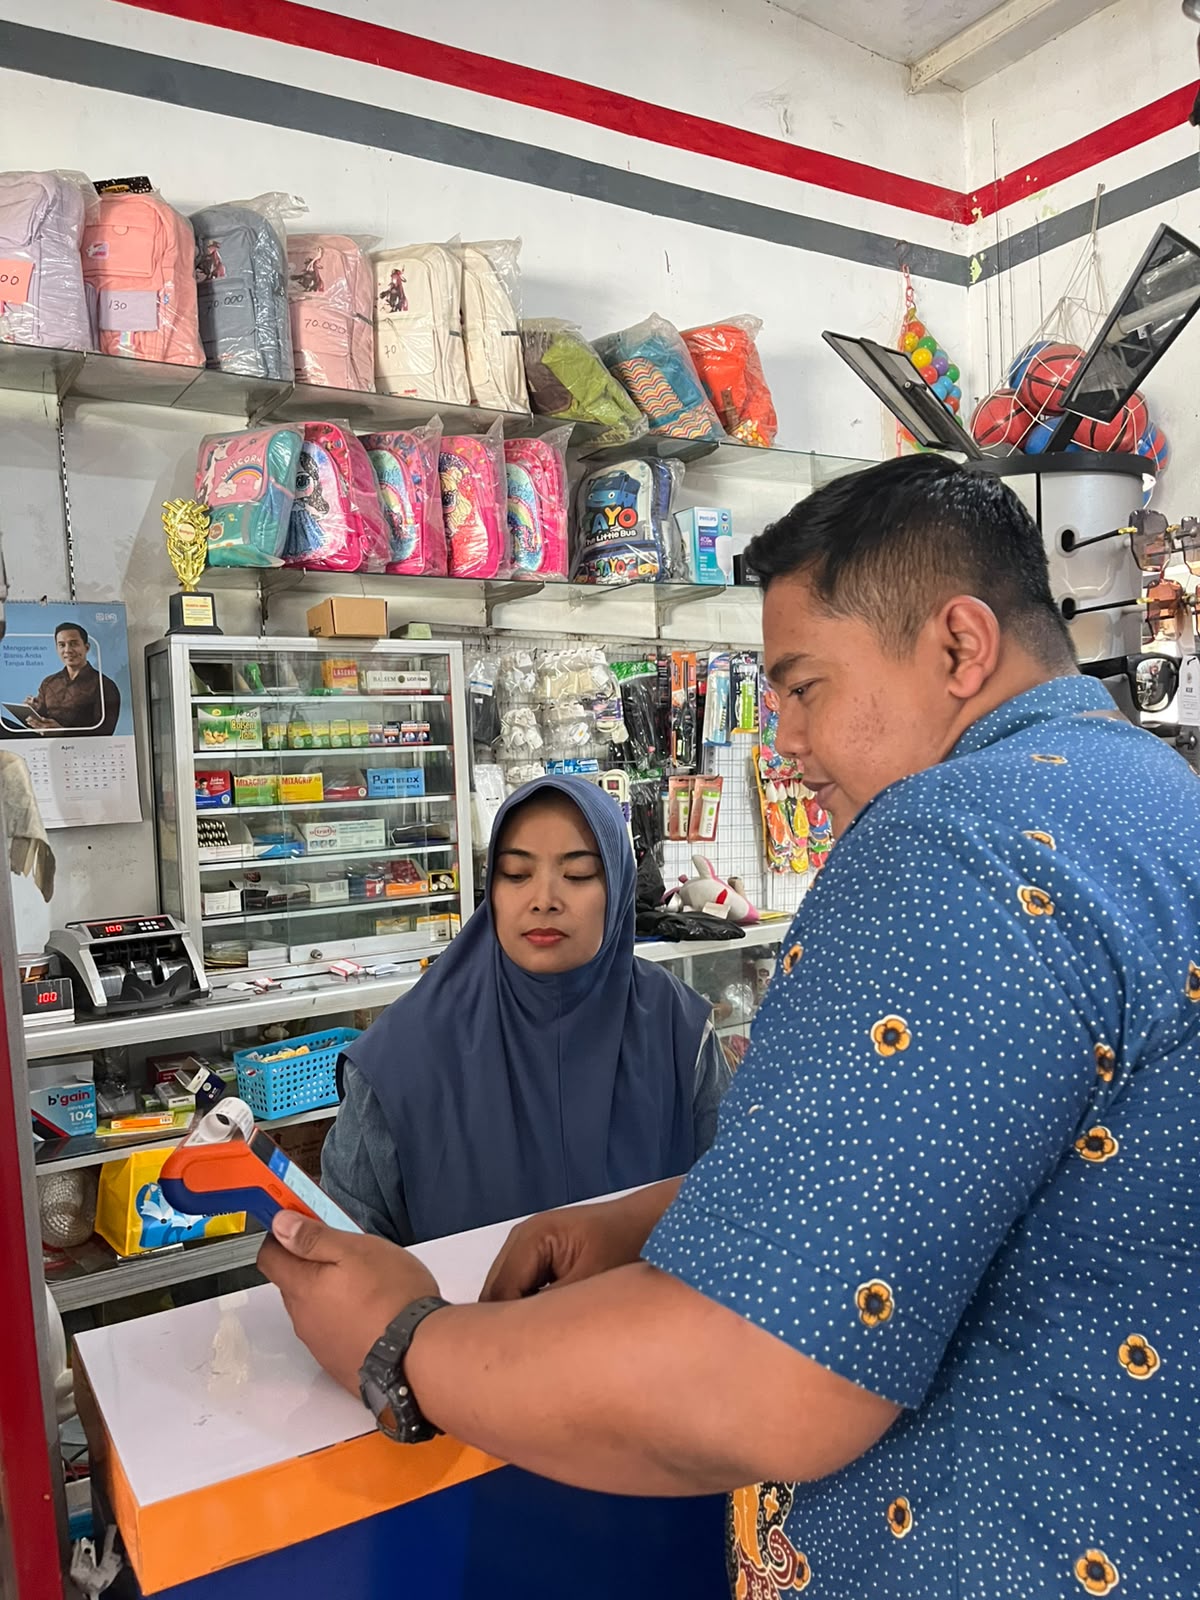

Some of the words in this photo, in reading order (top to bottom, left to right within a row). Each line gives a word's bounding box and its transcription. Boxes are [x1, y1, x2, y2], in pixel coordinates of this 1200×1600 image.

[109, 299, 127, 310] 130
[304, 318, 346, 335] 70.000
[221, 454, 262, 480] UNICORN
[596, 530, 620, 542] Little
[620, 529, 637, 538] Bus
[596, 556, 626, 578] TAYO
[282, 776, 312, 786] MIXAGRIP
[105, 924, 123, 933] 100
[38, 991, 58, 1004] 100
[48, 1090, 90, 1106] b'gain
[69, 1109, 93, 1122] 104
